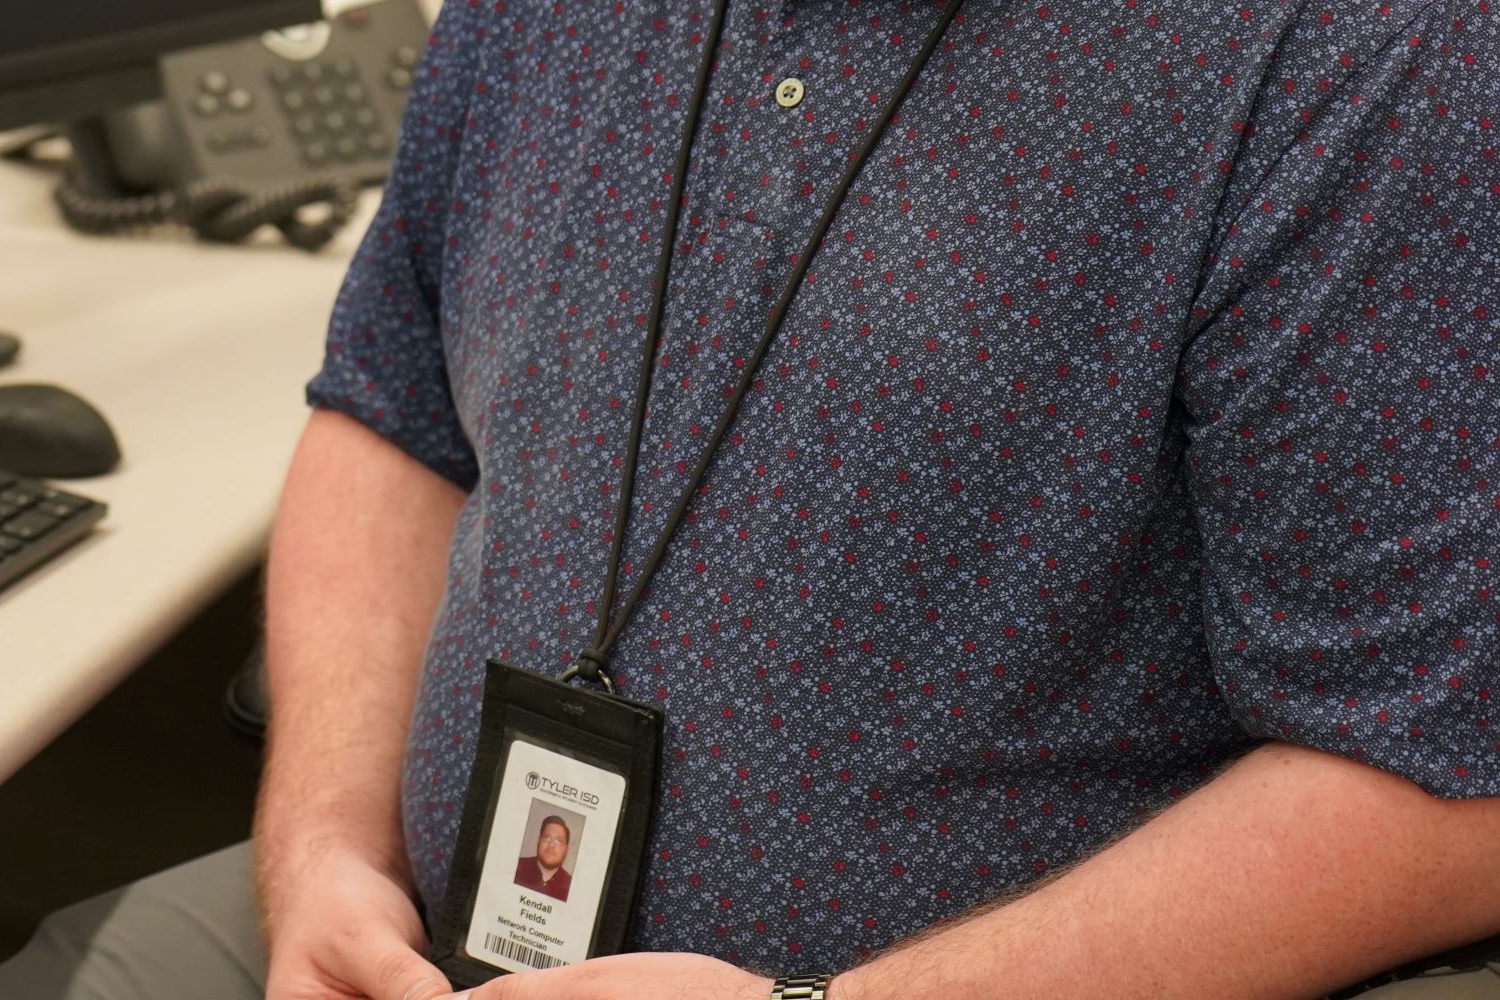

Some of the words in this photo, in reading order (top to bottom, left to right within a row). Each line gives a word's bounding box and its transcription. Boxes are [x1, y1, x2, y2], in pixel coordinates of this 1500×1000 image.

[542, 777, 578, 799] TYLER
[580, 791, 600, 805] ISD
[519, 895, 553, 914] Kendall
[520, 908, 547, 925] Fields
[497, 916, 527, 932] Network
[528, 927, 565, 946] Computer
[509, 930, 548, 951] Technician
